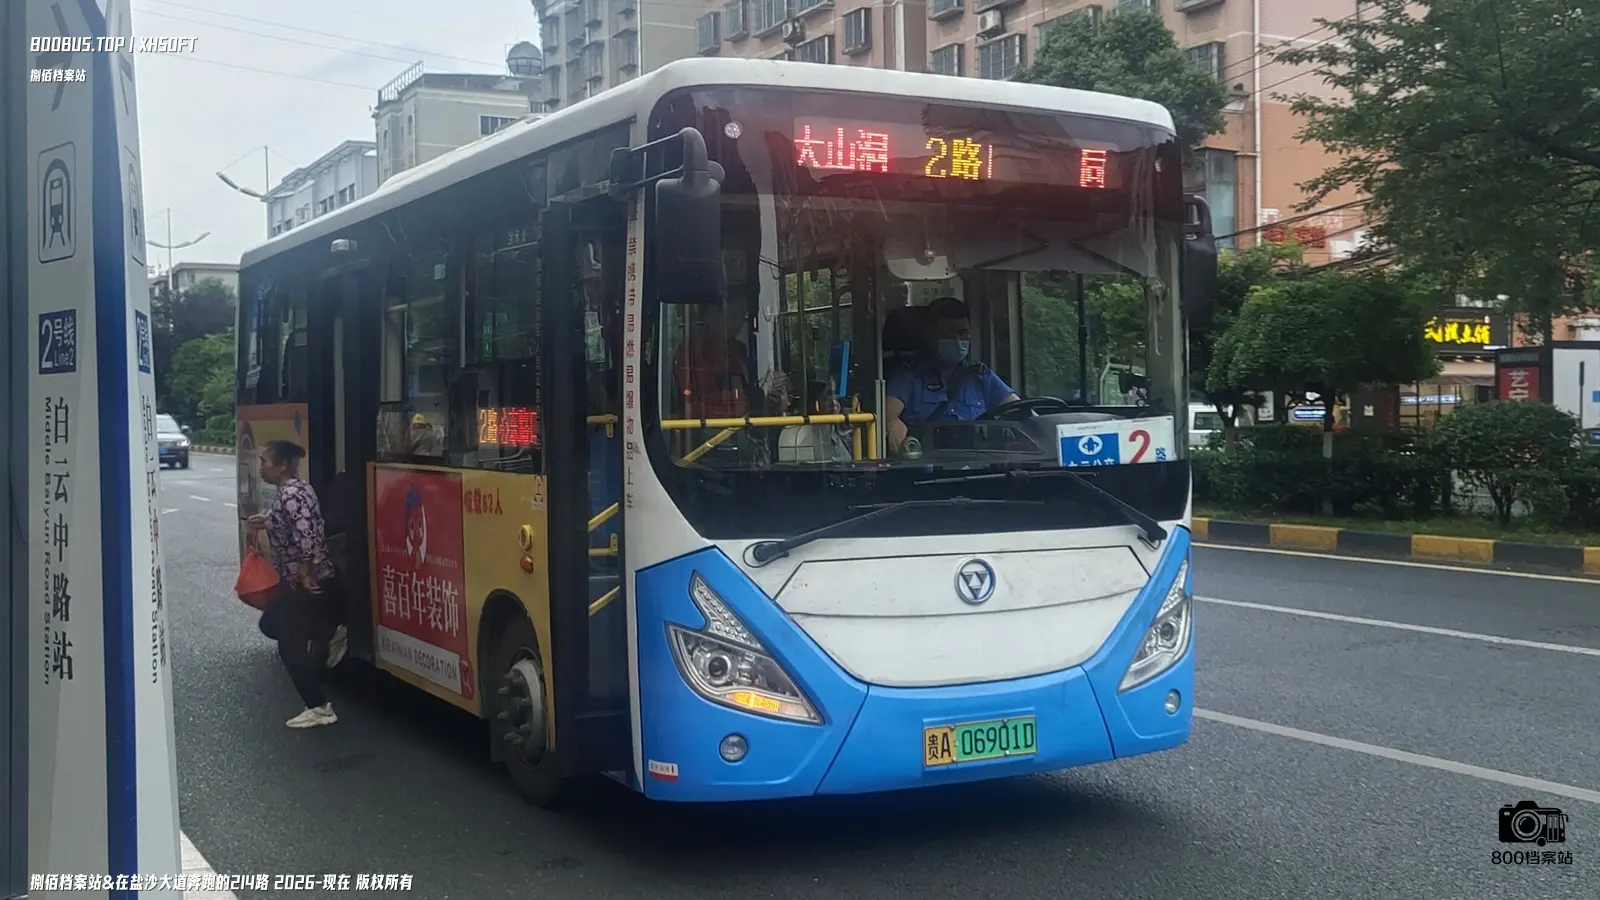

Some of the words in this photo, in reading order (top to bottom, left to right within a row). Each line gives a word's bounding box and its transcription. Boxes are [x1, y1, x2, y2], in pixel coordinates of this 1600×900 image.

[925, 137, 983, 180] 2路
[1128, 430, 1151, 464] 2
[53, 397, 73, 680] 白云中路站
[382, 564, 459, 638] 喜百年装饰
[413, 648, 458, 681] DECORATION
